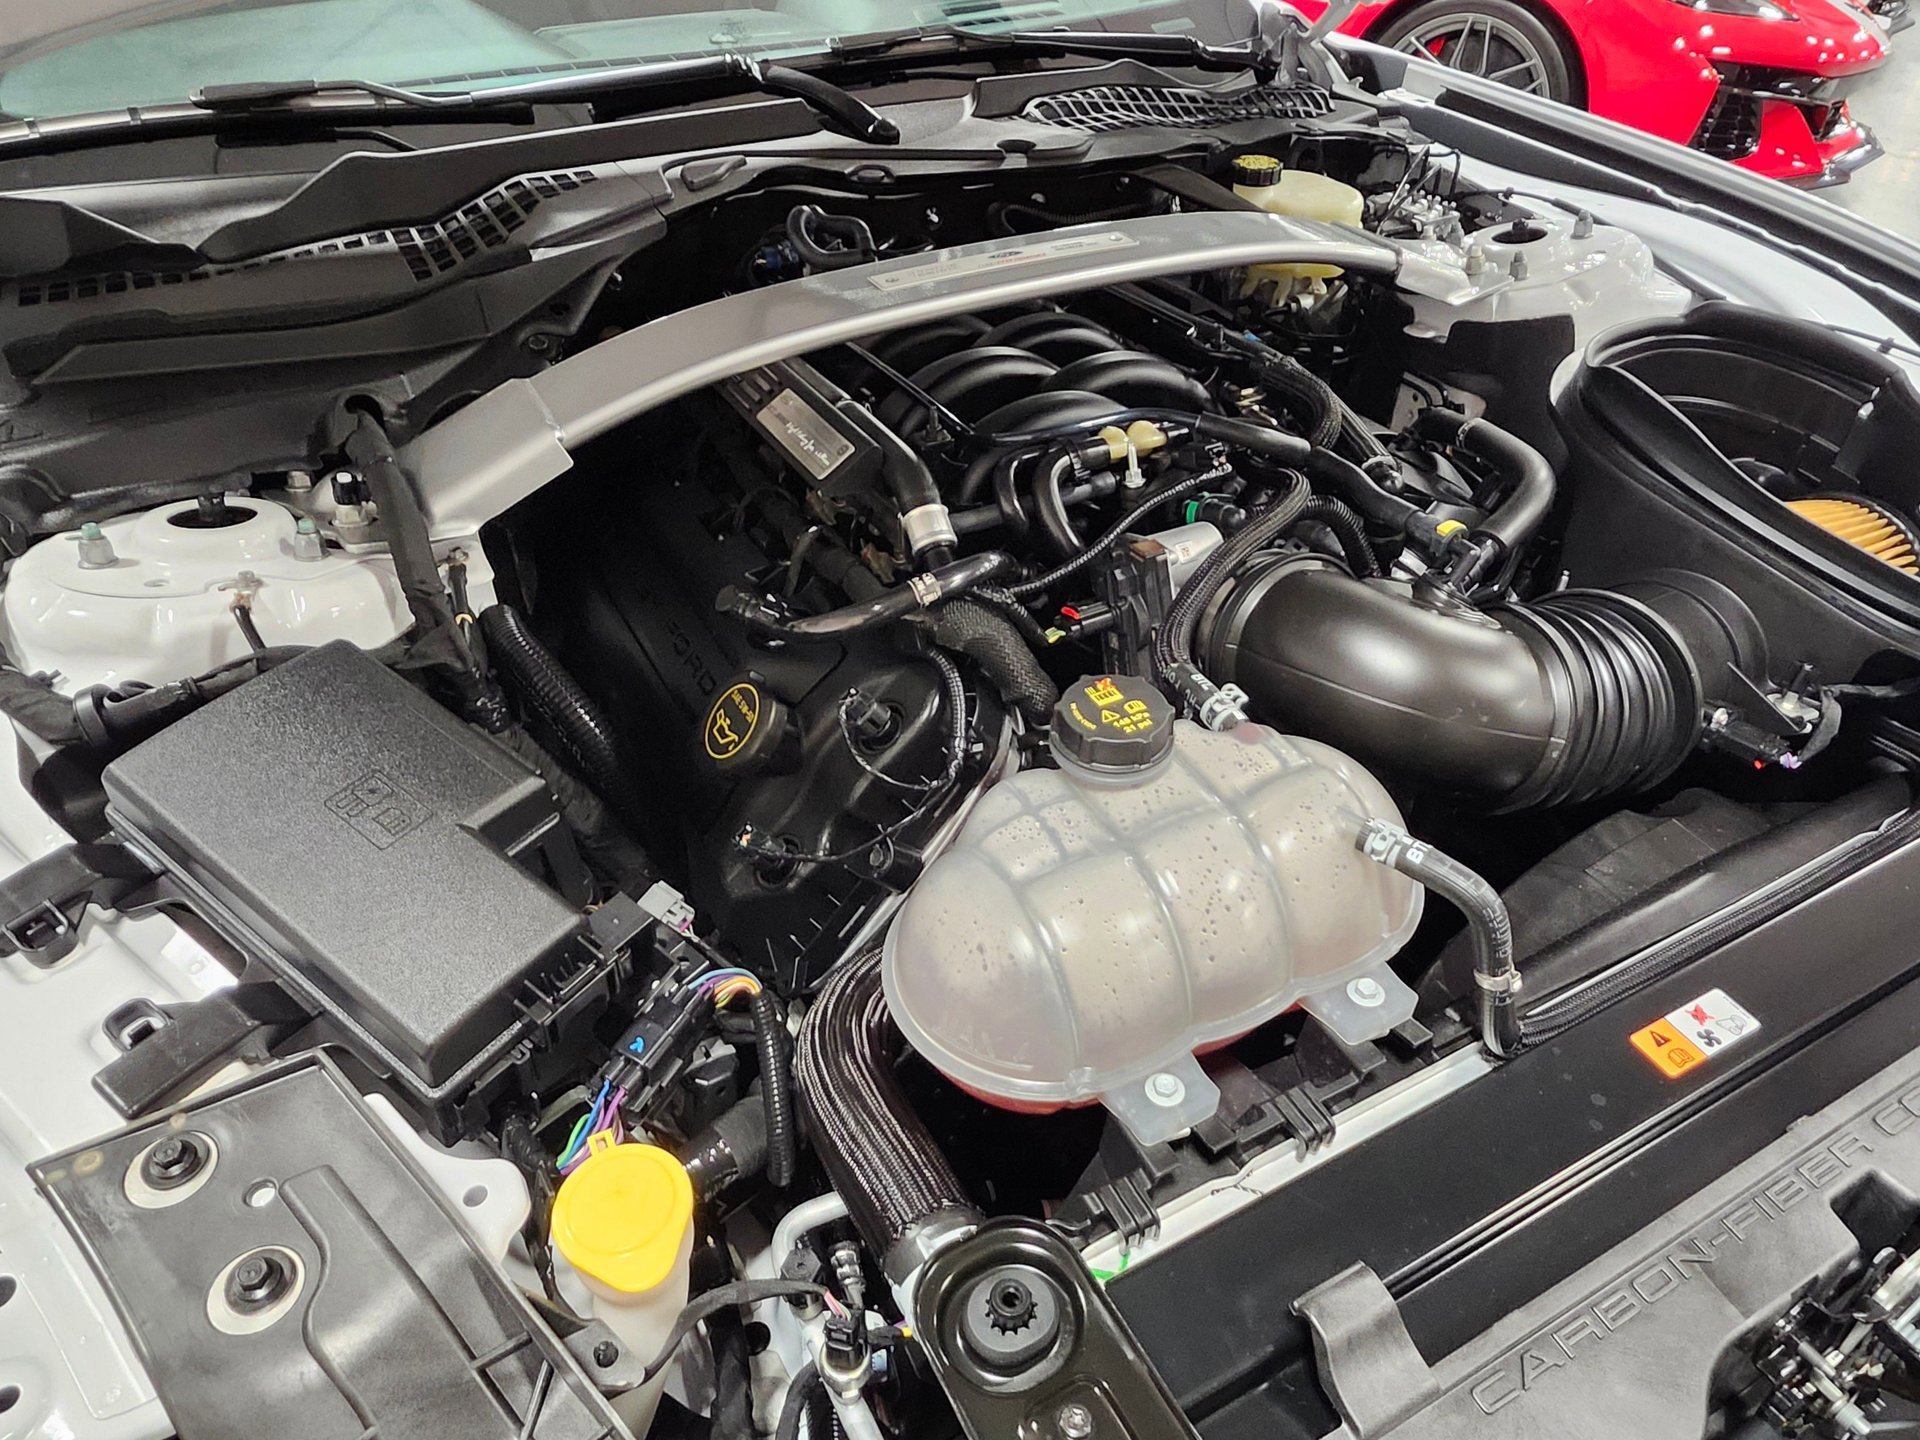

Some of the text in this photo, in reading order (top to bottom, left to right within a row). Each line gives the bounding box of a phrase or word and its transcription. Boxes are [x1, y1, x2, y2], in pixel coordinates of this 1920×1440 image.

[664, 619, 717, 696] FORD
[1123, 718, 1153, 734] 21 psi
[1130, 711, 1151, 723] kPa
[1471, 1131, 1875, 1415] CARBON-FIBER
